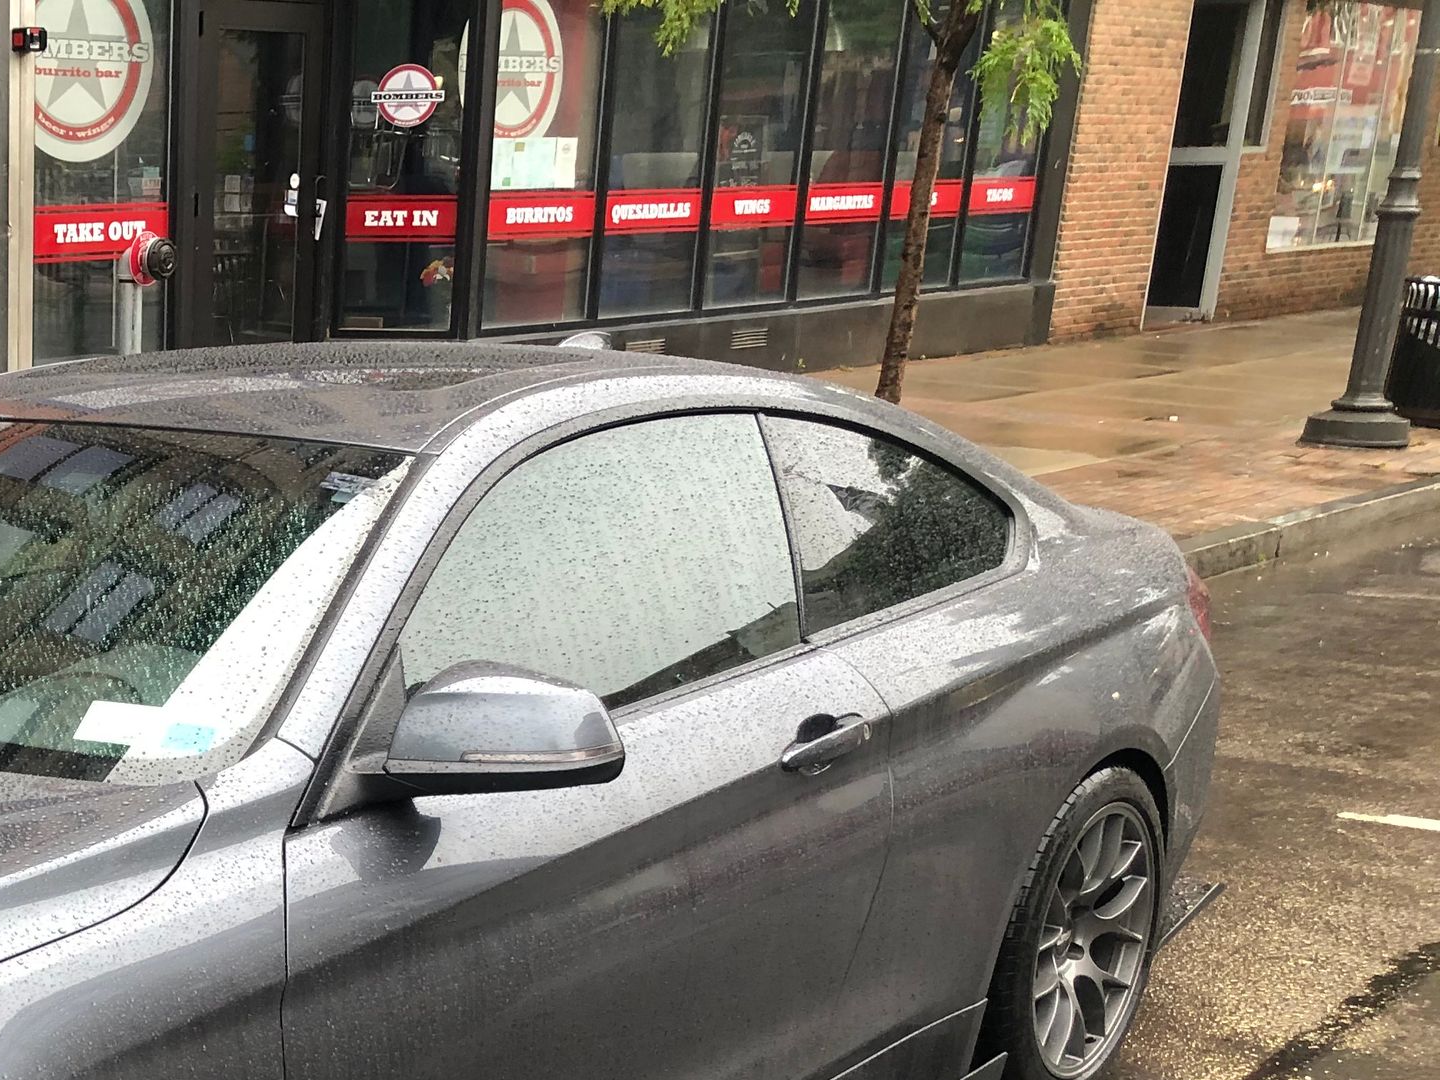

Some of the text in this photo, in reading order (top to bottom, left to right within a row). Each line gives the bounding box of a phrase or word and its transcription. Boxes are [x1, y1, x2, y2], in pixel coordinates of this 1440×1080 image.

[35, 38, 150, 63] MBERS
[35, 65, 122, 78] burrito bar
[373, 92, 444, 101] BOMBERS
[38, 111, 115, 138] beer wings
[987, 188, 1014, 202] TACOS
[506, 206, 574, 224] BURRITOS
[611, 201, 691, 222] QUESADILLAS
[734, 198, 771, 215] WINGS
[364, 209, 439, 227] EAT IN
[53, 222, 105, 243] TAKE
[107, 220, 147, 242] OUT
